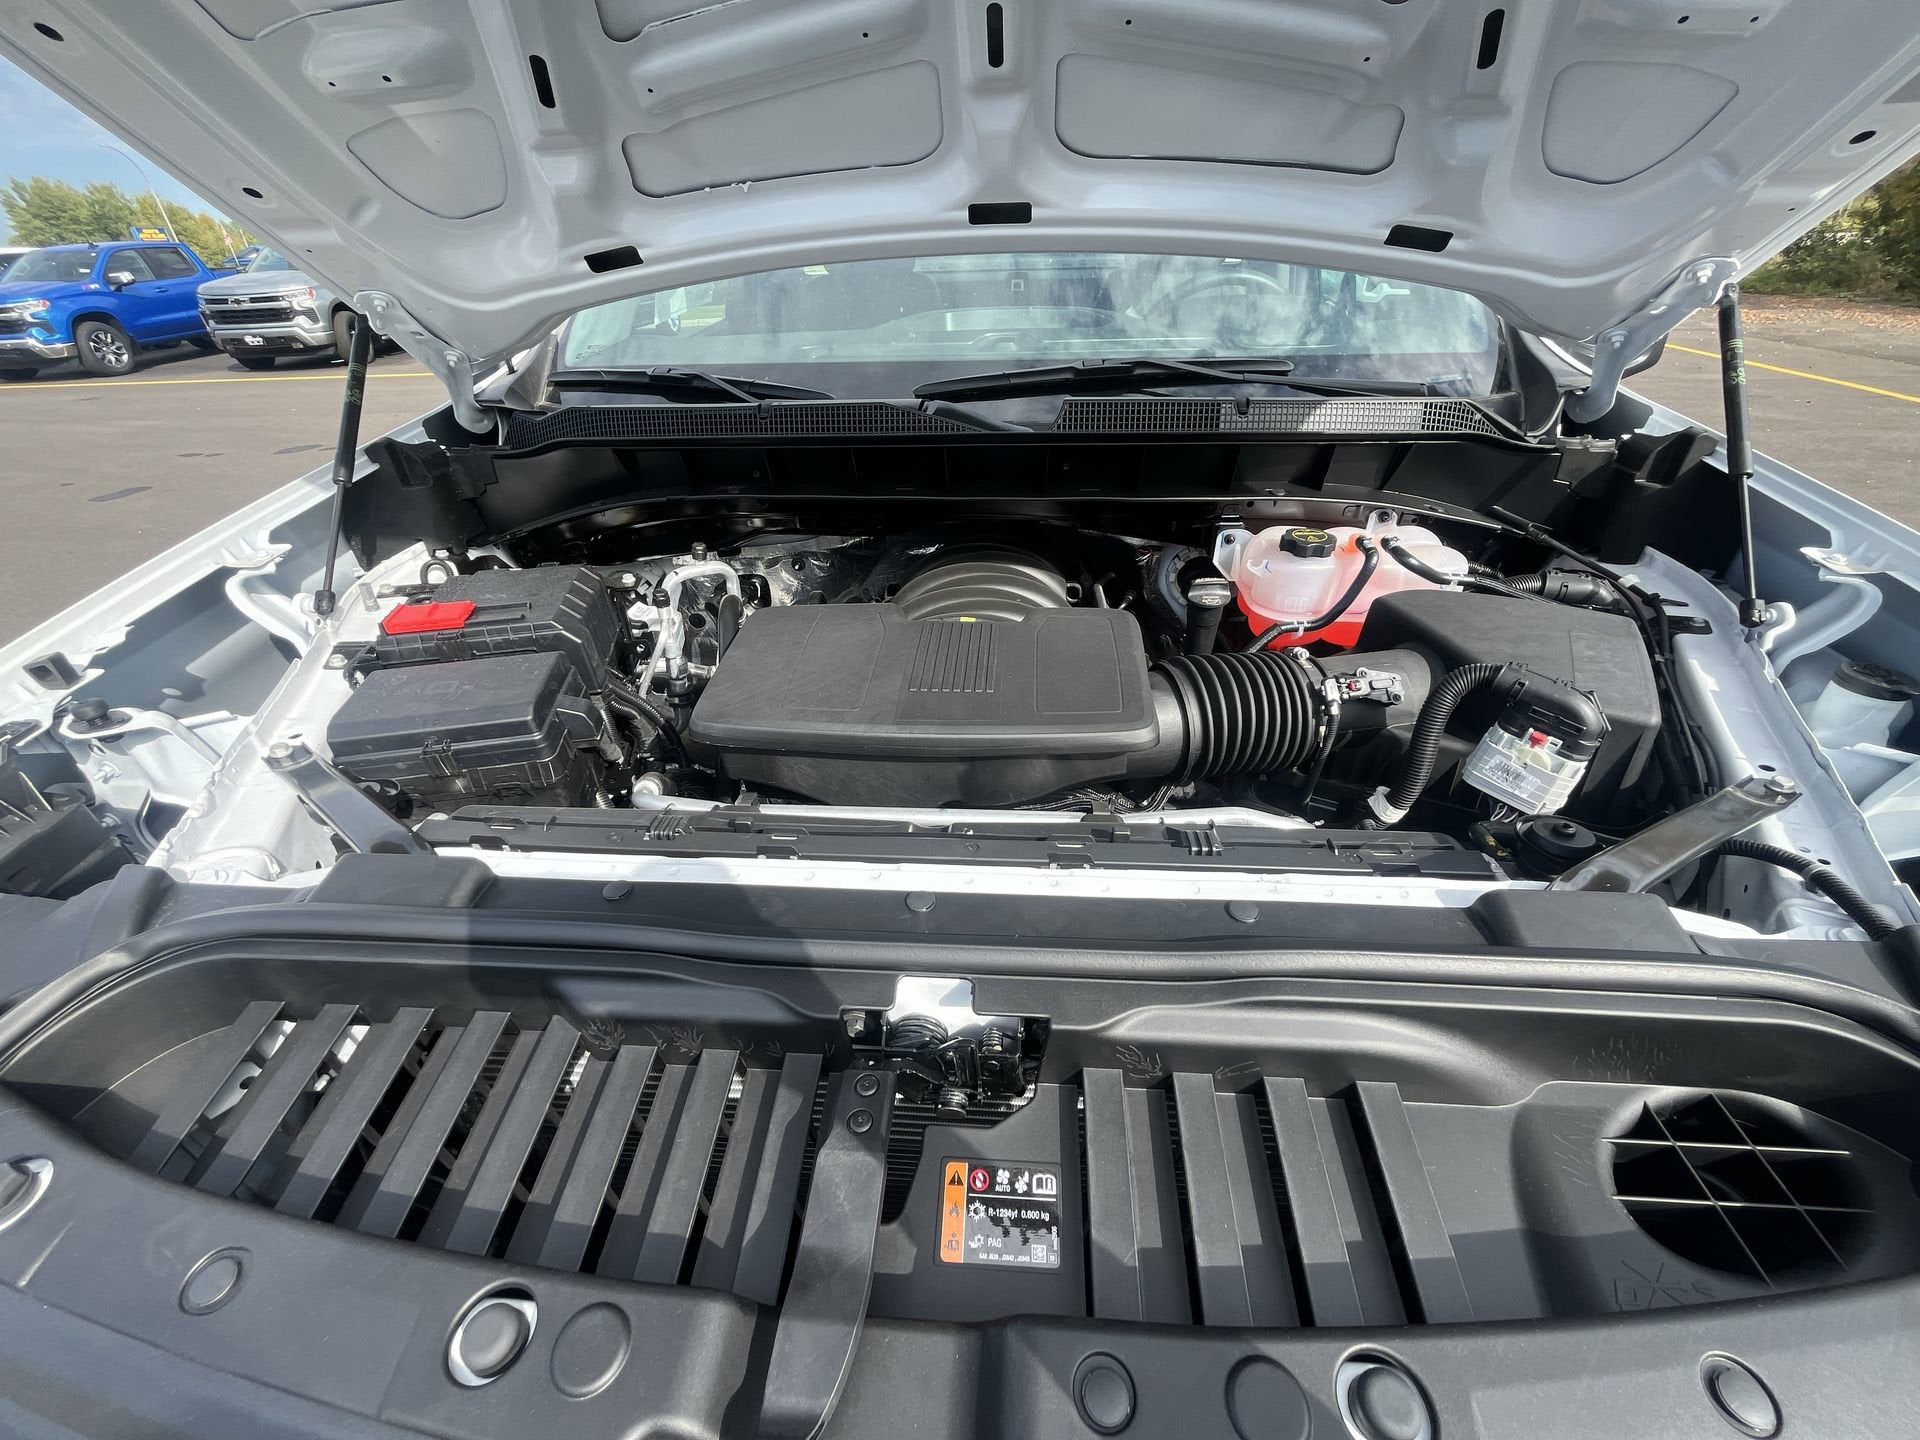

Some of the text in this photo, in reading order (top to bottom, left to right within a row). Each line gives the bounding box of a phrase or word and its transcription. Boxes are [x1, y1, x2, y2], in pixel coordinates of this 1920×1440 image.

[995, 1184, 1011, 1192] AUTO
[988, 1207, 1050, 1221] R-1234yf 0.600 kg
[987, 1238, 1001, 1247] PAG
